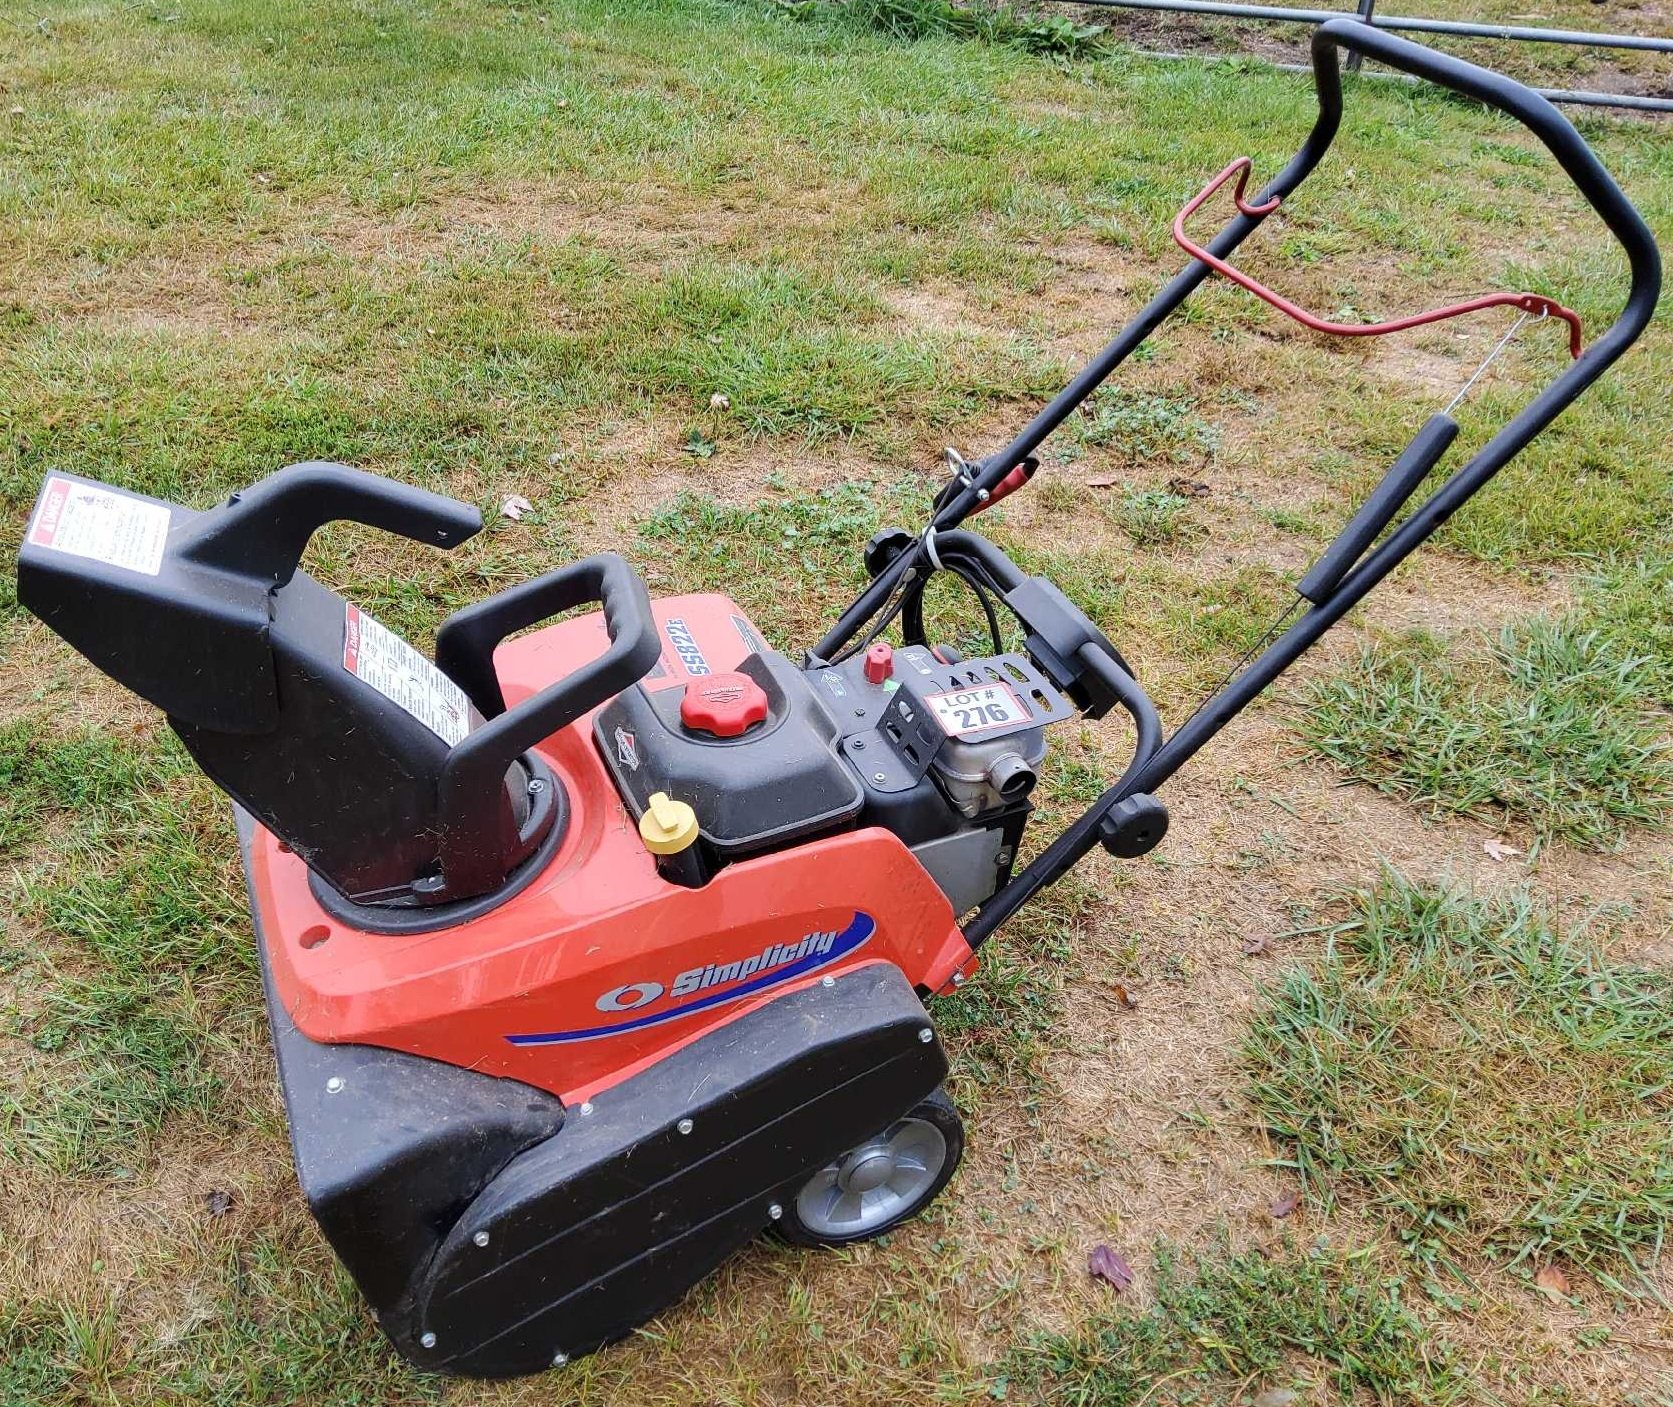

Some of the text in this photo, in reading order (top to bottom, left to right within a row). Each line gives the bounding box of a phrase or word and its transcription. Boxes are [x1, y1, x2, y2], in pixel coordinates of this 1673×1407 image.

[349, 620, 358, 648] DANGER
[666, 619, 710, 675] SS822E
[944, 691, 980, 707] LOT
[953, 703, 1009, 729] 276
[669, 931, 837, 997] Simplicity
